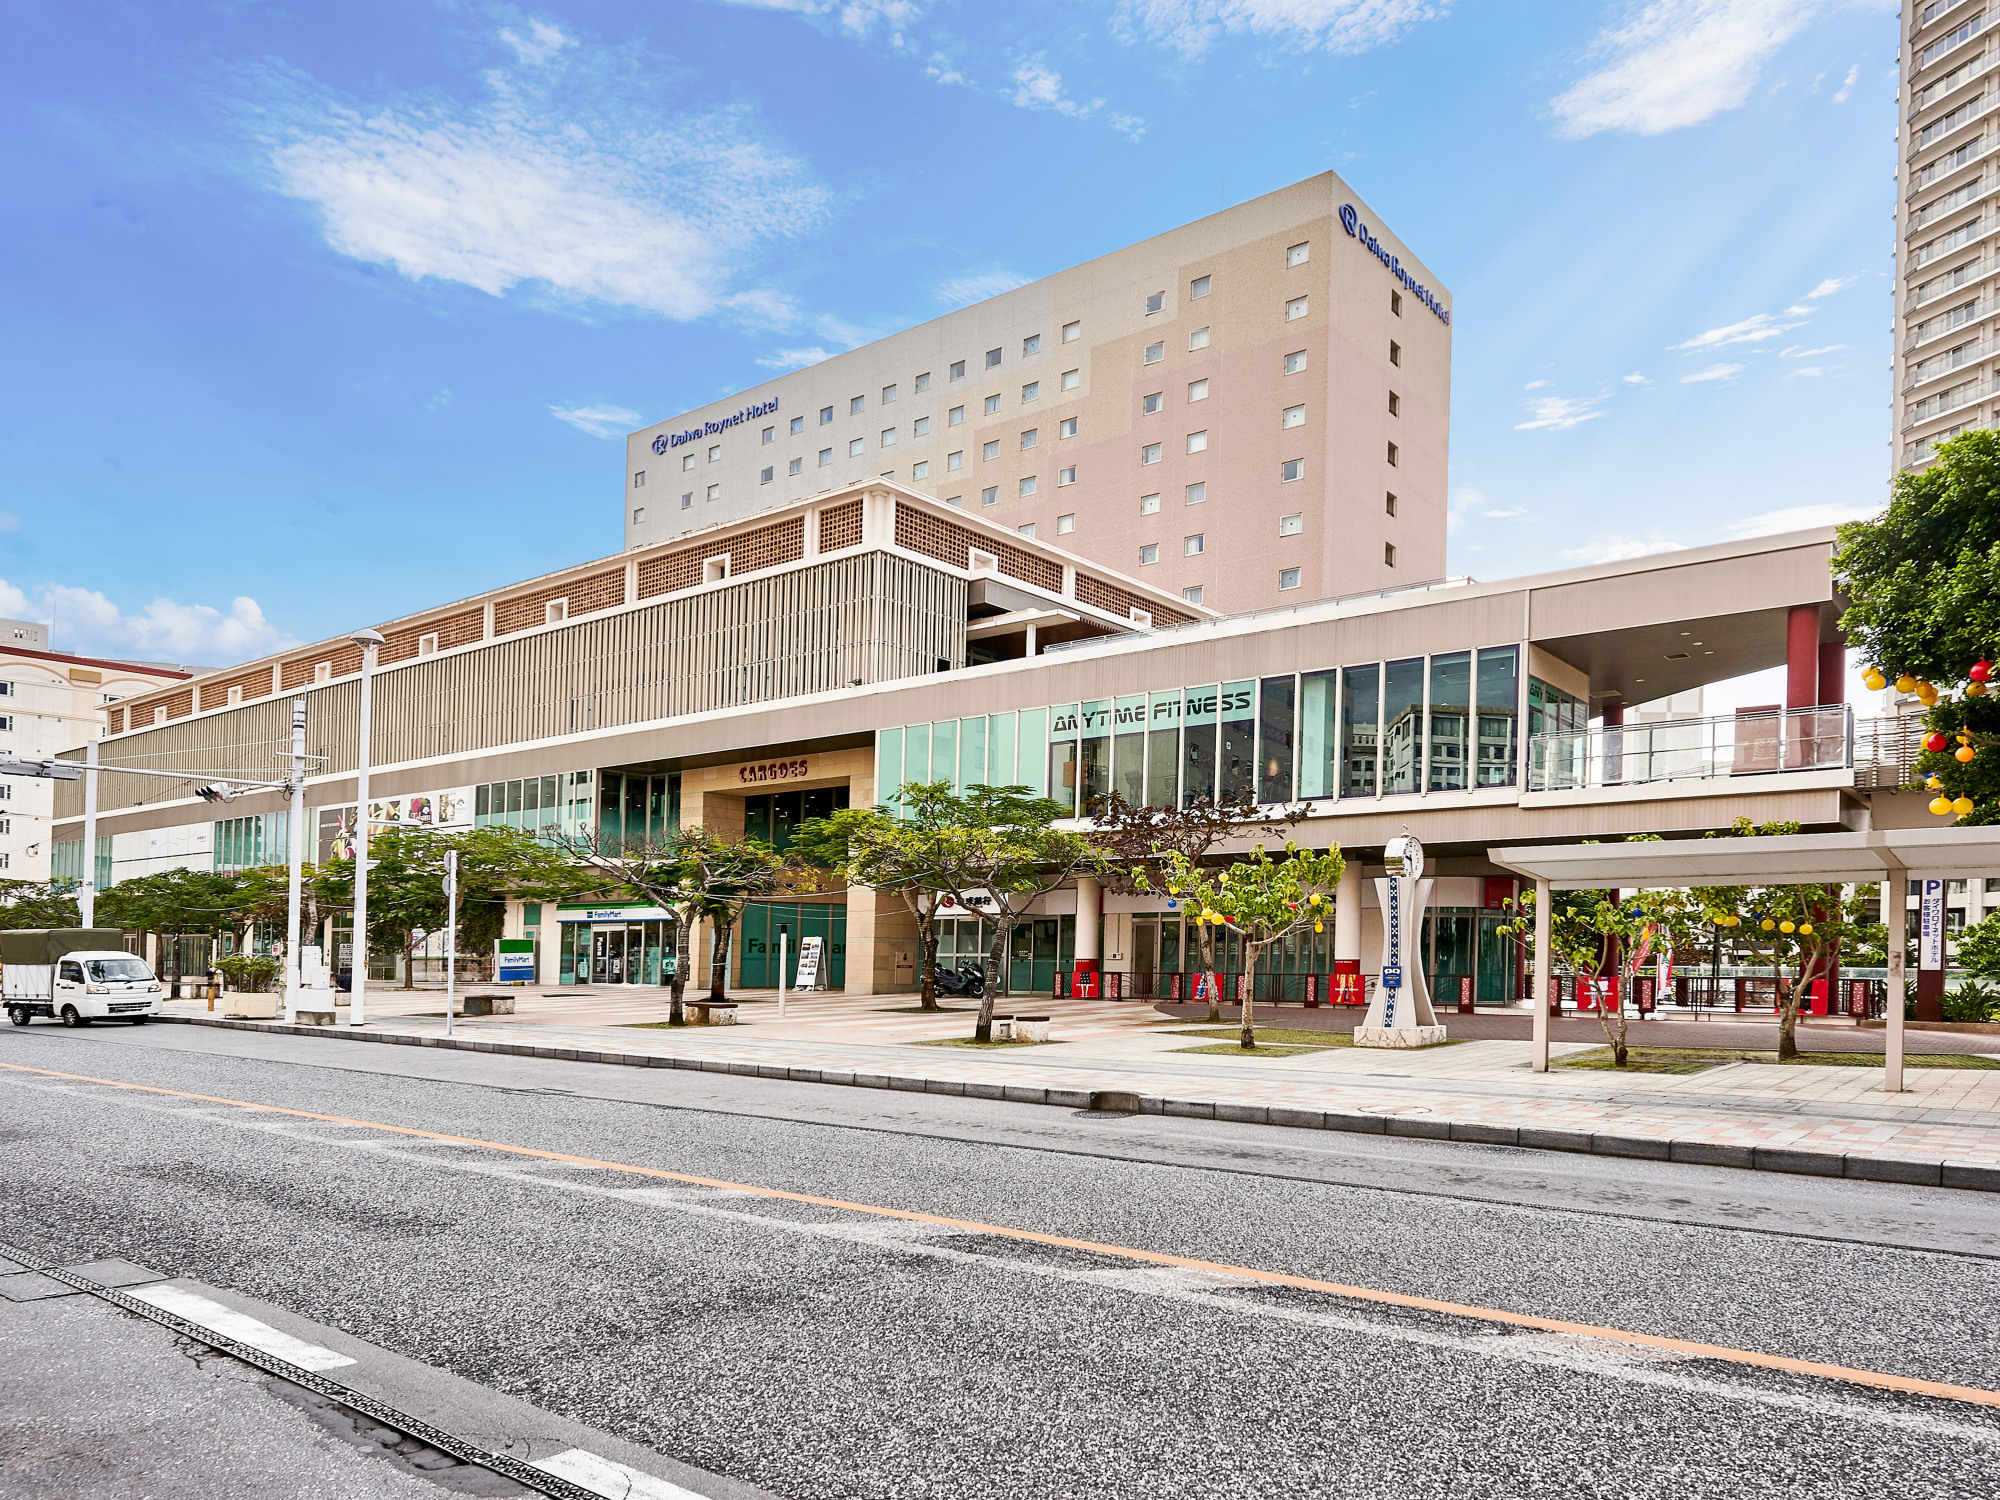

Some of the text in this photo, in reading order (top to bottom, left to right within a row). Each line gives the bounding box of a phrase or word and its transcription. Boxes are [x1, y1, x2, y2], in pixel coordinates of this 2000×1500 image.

[1359, 222, 1391, 268] Daiwa
[1391, 255, 1425, 302] Roynet
[1425, 289, 1450, 326] Hotel
[670, 428, 702, 447] Daiwa
[704, 410, 744, 434] Roynet
[745, 396, 779, 421] Hotel
[1153, 691, 1251, 720] FITNESS
[739, 759, 808, 783] CARGOES
[1926, 879, 1941, 895] P
[594, 909, 622, 919] FamilyMart
[1931, 898, 1942, 962] ダイワロイネットホテル
[504, 956, 530, 964] FamilyMart
